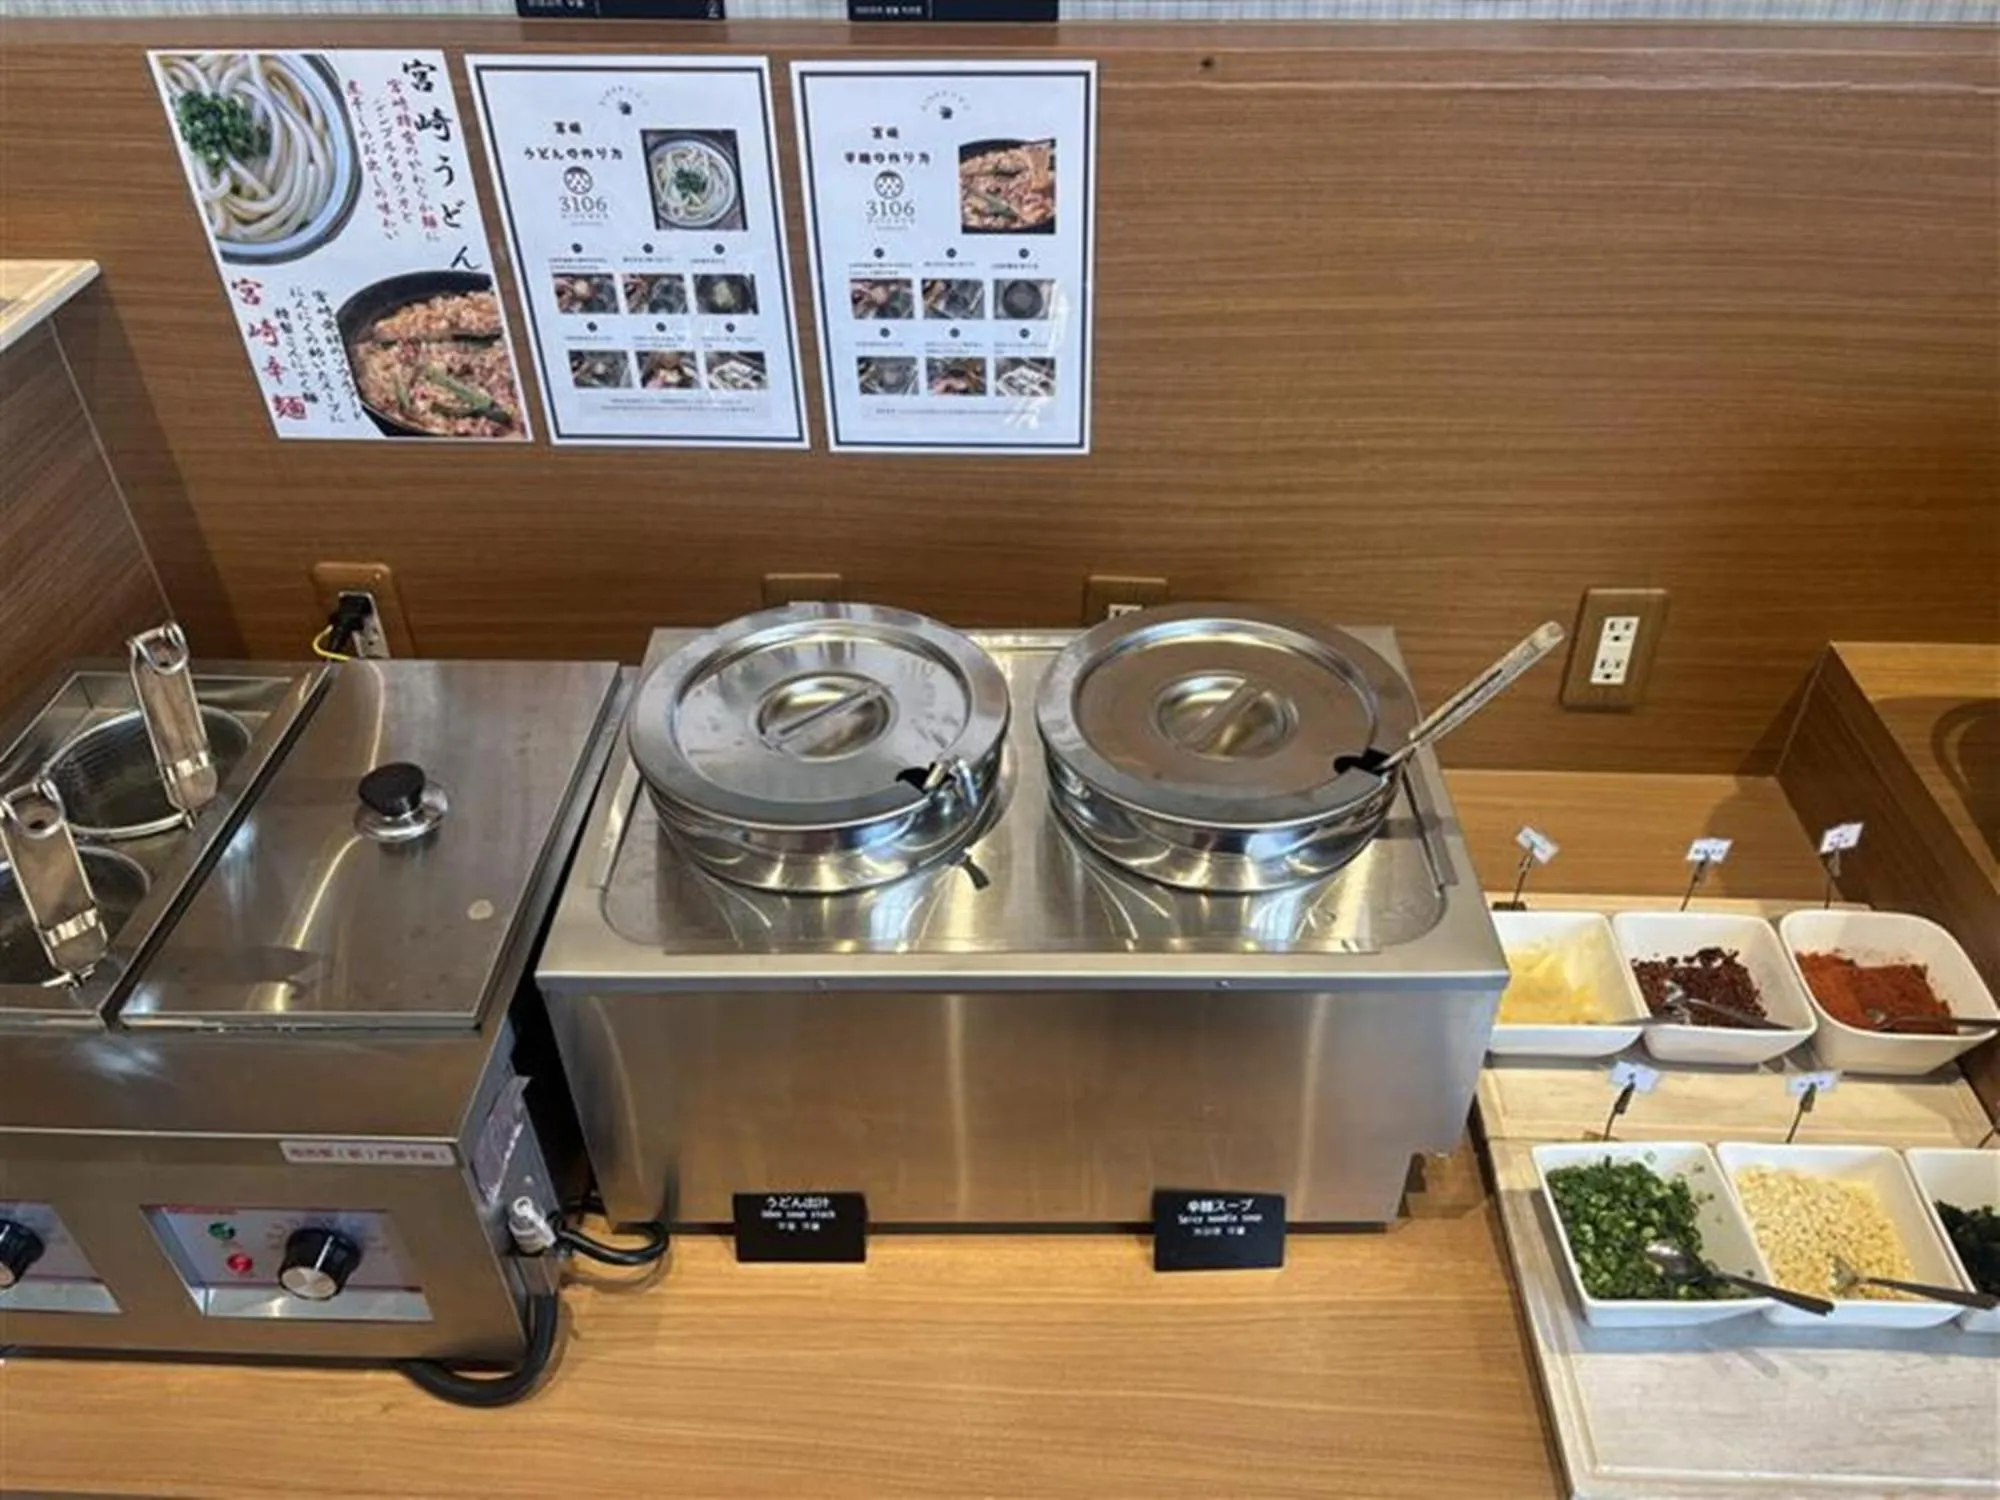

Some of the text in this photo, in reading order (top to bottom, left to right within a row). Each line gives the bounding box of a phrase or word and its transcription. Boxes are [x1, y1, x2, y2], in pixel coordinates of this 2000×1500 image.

[402, 58, 481, 270] 宮崎うどん
[559, 196, 608, 213] 3106
[865, 200, 916, 217] 3106
[231, 277, 308, 421] 宮崎辛麺
